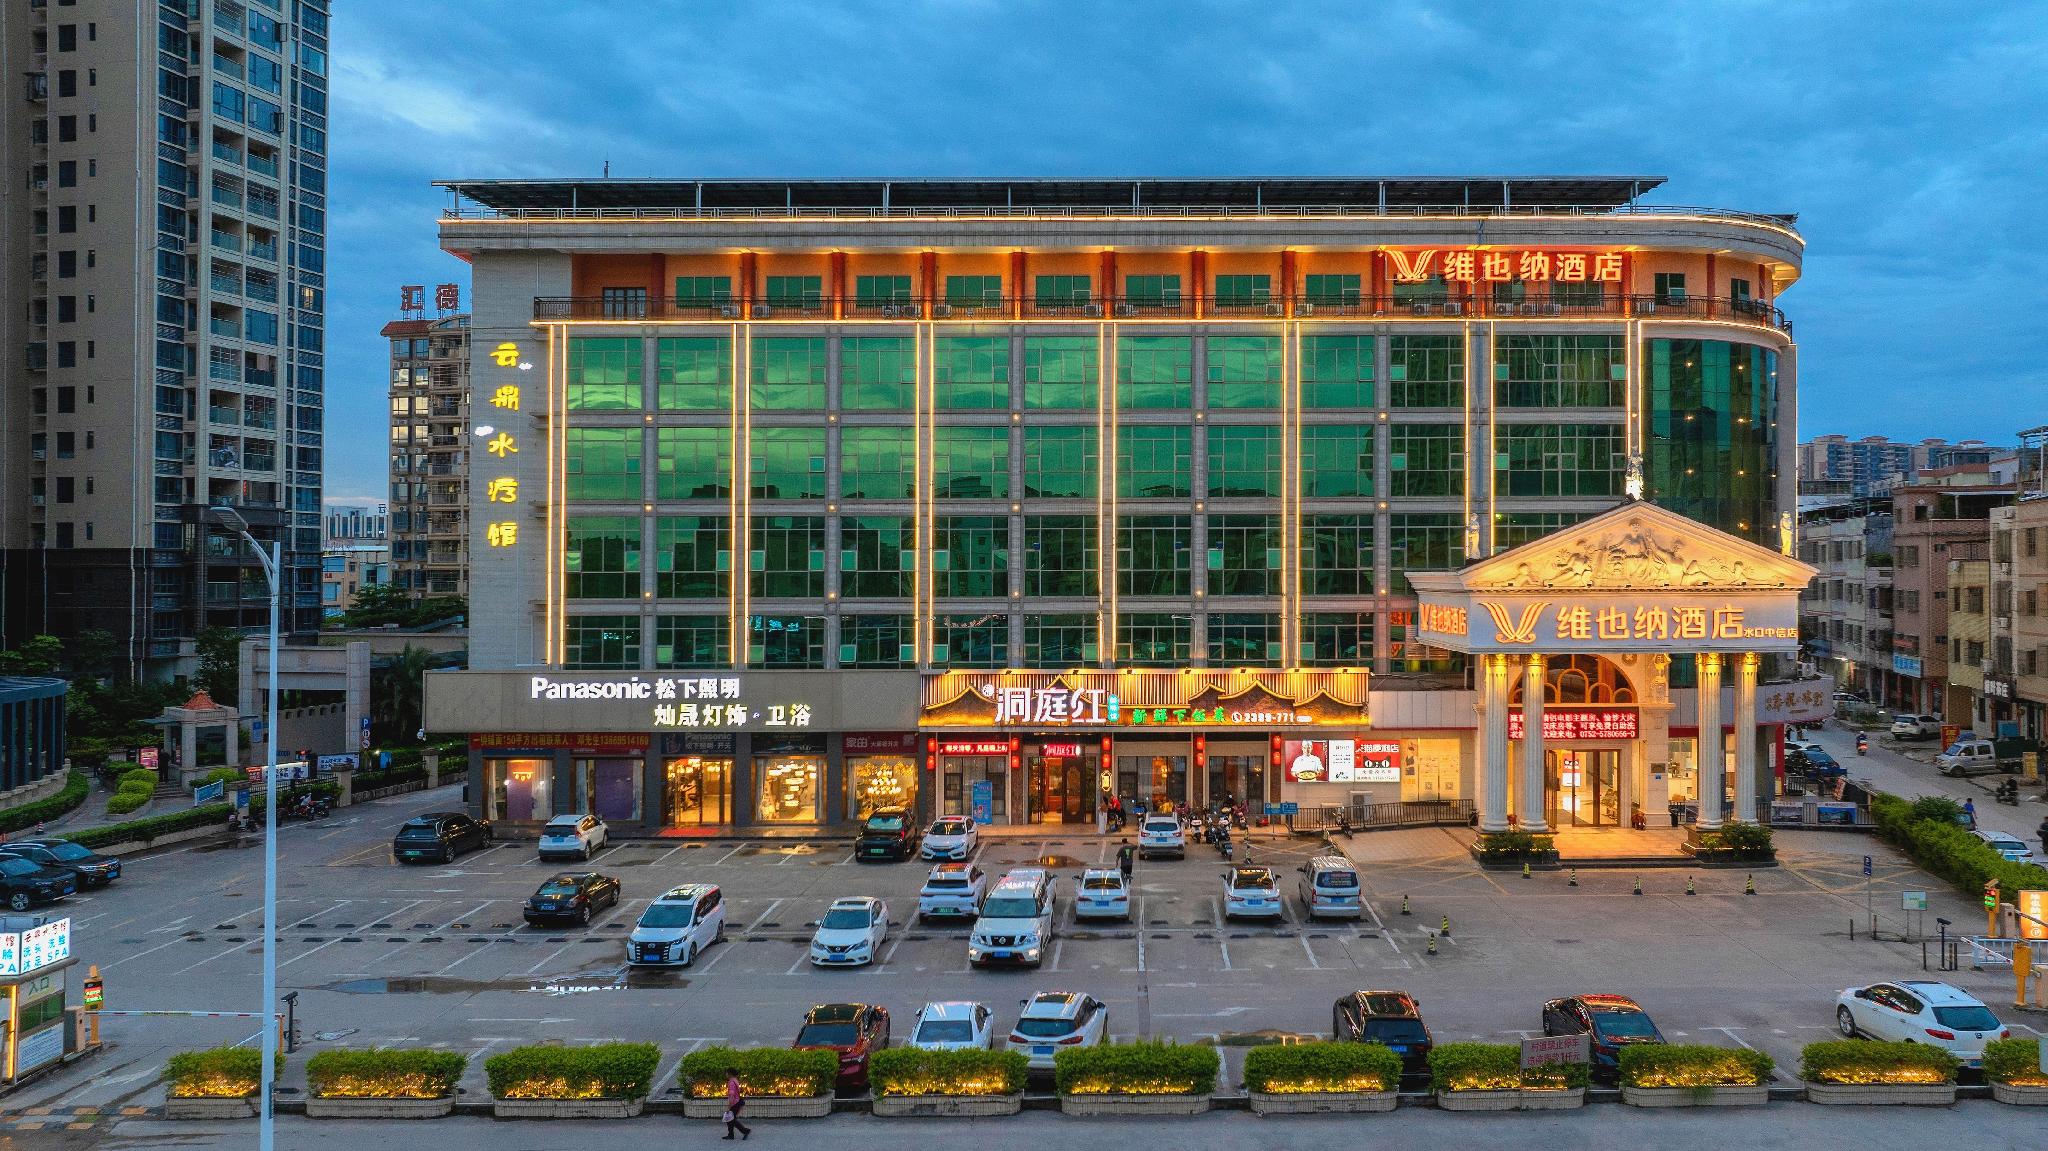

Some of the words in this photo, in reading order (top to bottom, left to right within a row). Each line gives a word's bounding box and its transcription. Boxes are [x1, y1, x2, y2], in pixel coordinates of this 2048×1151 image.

[1443, 251, 1623, 283] 维也纳酒店
[487, 341, 520, 548] 云鼎水疗馆
[1556, 603, 1745, 640] 维也纳酒店
[1743, 627, 1798, 639] 水口中信店
[531, 676, 650, 699] Panasonic
[655, 677, 740, 699] 松下照明
[994, 686, 1107, 723] 洞庭红
[684, 733, 732, 741] Panasonic
[47, 947, 68, 962] SPA
[28, 976, 49, 996] 入口
